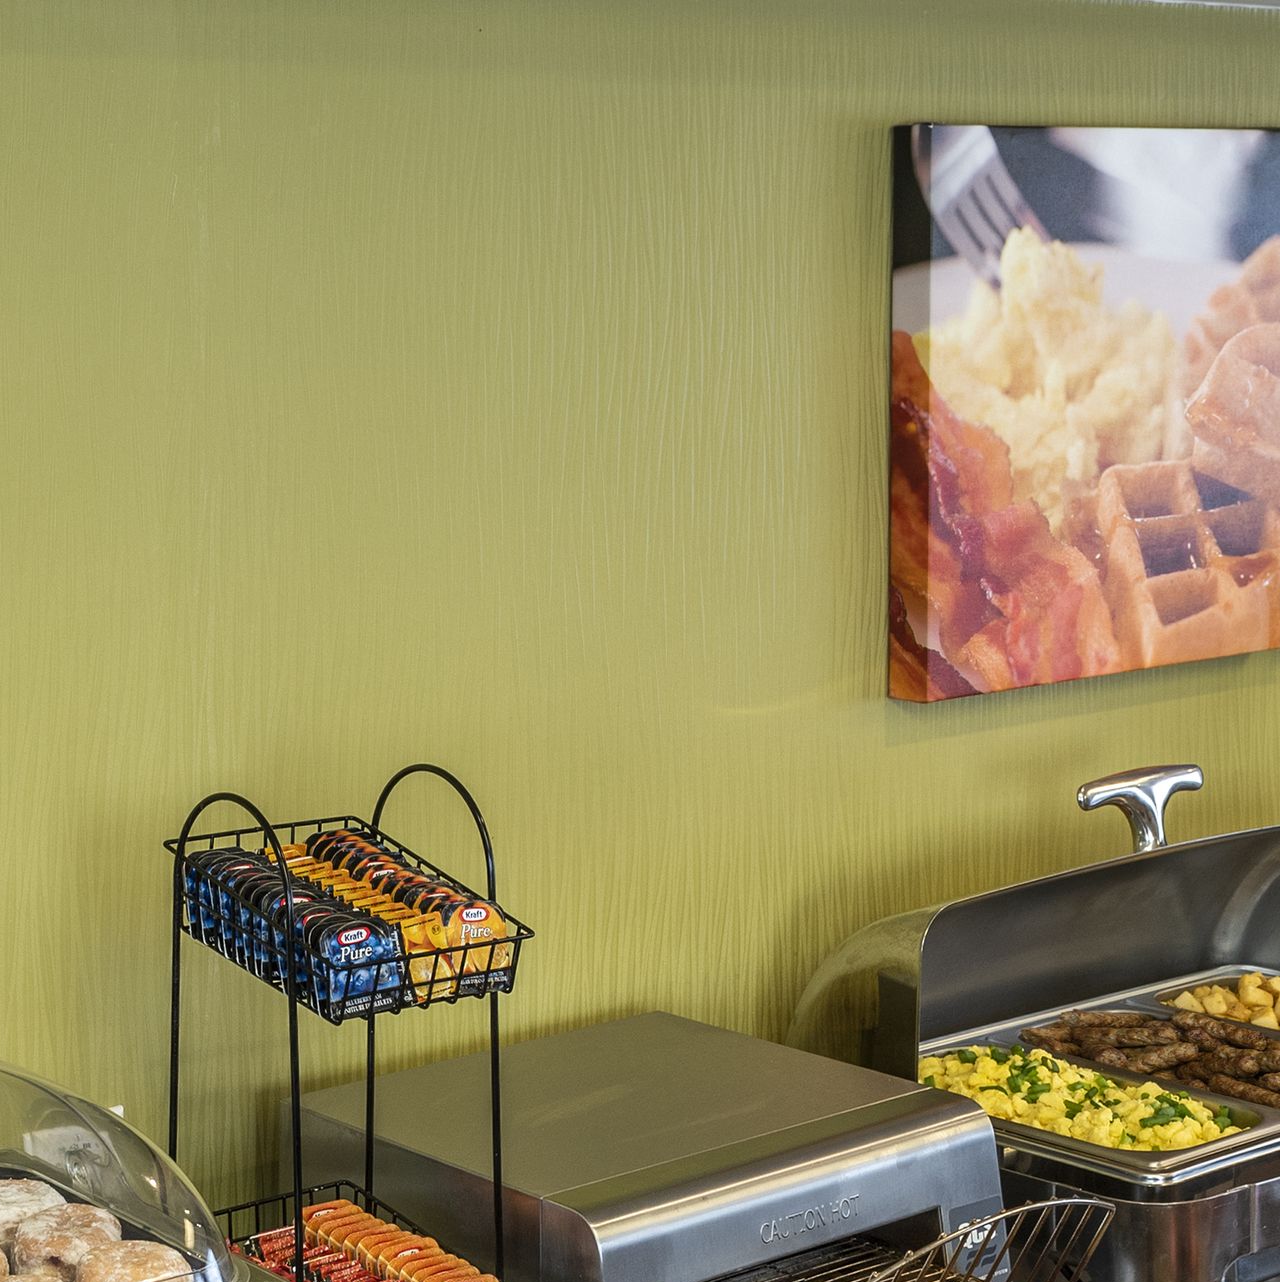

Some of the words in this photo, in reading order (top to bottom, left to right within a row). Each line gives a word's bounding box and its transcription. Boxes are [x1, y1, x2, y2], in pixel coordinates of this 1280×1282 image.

[465, 909, 483, 919] Kraft
[344, 930, 364, 942] Kraft
[461, 924, 491, 940] Pure
[340, 946, 373, 963] Pure
[760, 1206, 826, 1245] CAUTION
[829, 1193, 860, 1224] HOT
